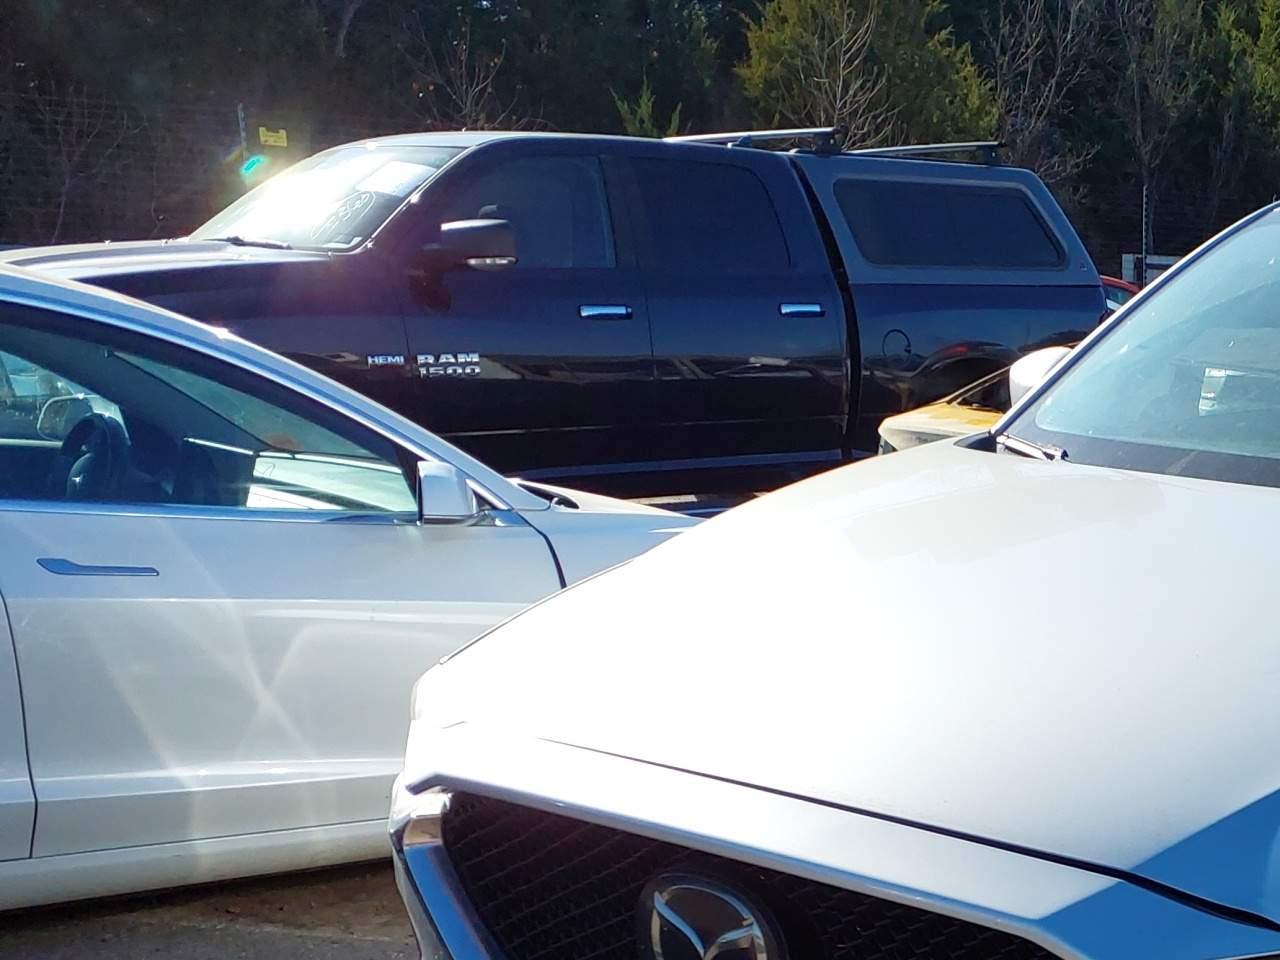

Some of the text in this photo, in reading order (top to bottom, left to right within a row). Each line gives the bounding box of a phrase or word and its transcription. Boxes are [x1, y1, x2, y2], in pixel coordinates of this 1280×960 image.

[367, 355, 405, 366] HEMI
[416, 352, 480, 365] RAM
[418, 365, 481, 378] 1500
